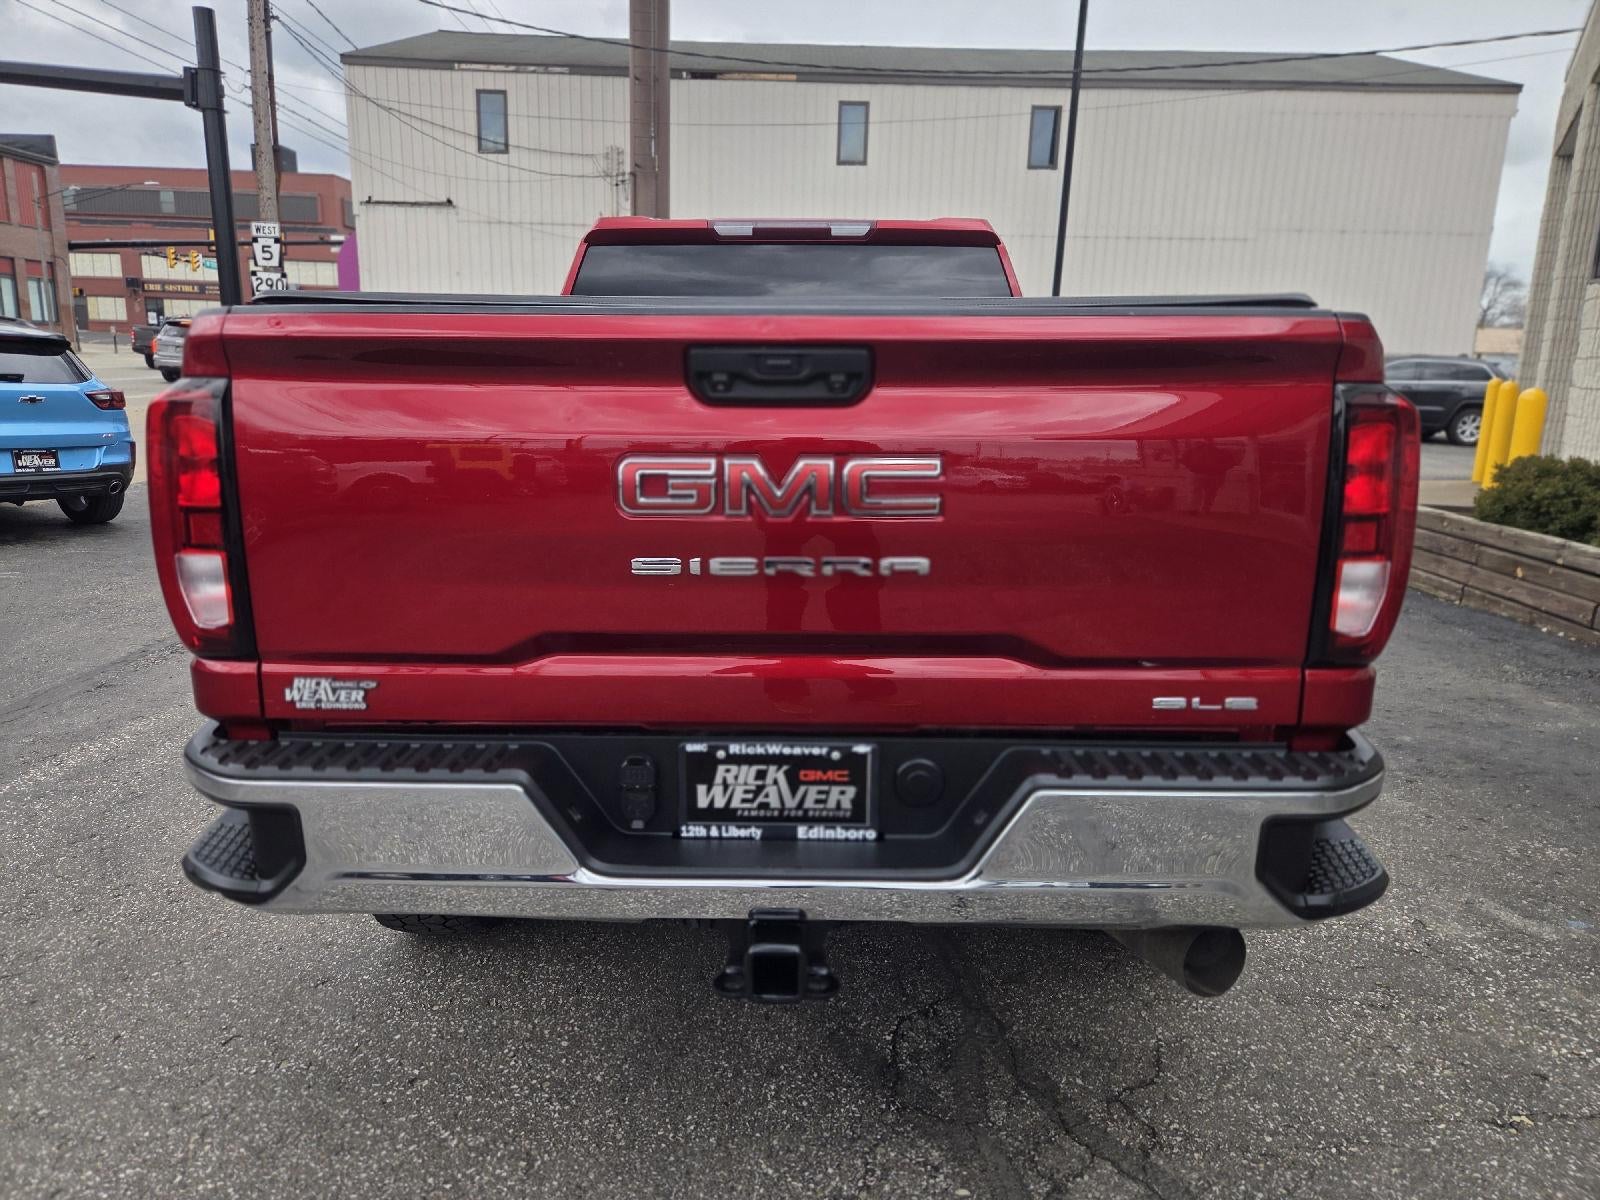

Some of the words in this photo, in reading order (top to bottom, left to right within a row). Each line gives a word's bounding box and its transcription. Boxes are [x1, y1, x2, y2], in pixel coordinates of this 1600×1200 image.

[255, 225, 277, 234] WEST
[261, 245, 273, 260] 5
[255, 277, 285, 292] 290
[18, 459, 56, 467] WEAVER
[617, 456, 942, 517] GMC
[631, 557, 931, 576] SIERRA
[293, 677, 333, 690] RICK
[284, 687, 366, 703] WEAVER
[685, 744, 709, 753] GMC
[713, 765, 790, 786] RICK
[799, 769, 850, 782] GMC
[696, 783, 857, 809] WEAVER
[737, 809, 779, 818] FAMOUS
[783, 809, 805, 818] FOR
[807, 809, 851, 818] SERVICE
[680, 825, 707, 838] 12th
[709, 826, 719, 837] &
[721, 825, 763, 840] Liberty
[797, 825, 877, 840] Edinboro
